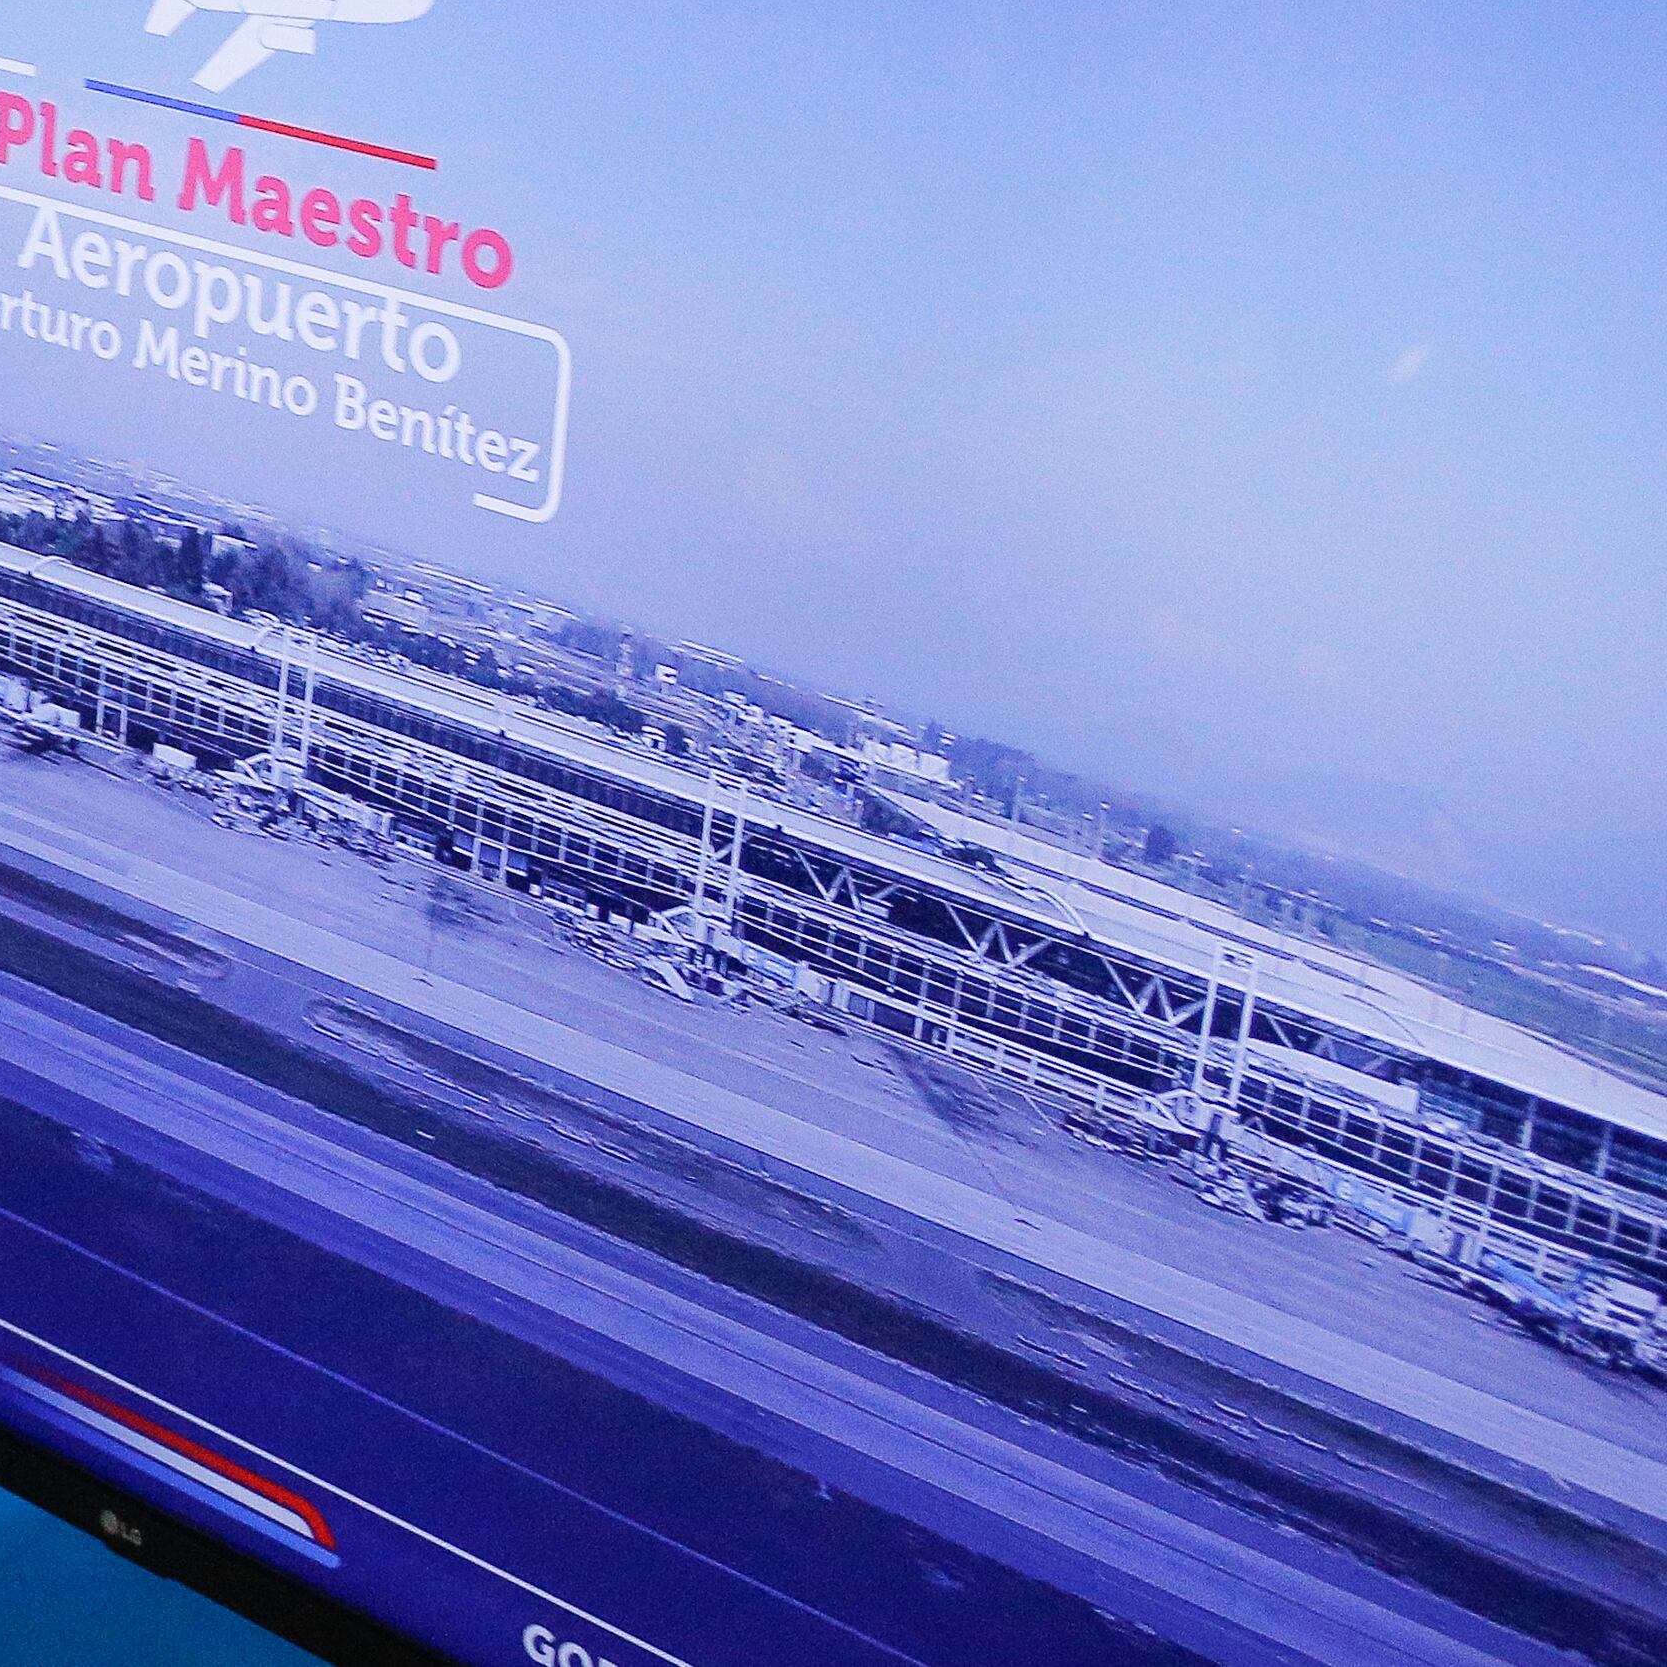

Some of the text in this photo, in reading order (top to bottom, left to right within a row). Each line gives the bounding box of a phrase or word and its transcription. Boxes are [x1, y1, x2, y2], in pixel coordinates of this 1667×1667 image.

[177, 136, 515, 291] Maestro
[17, 206, 464, 385] Aeropuerto
[131, 317, 319, 418] Merino
[332, 371, 542, 485] Benítez
[522, 1623, 620, 1667] GO
